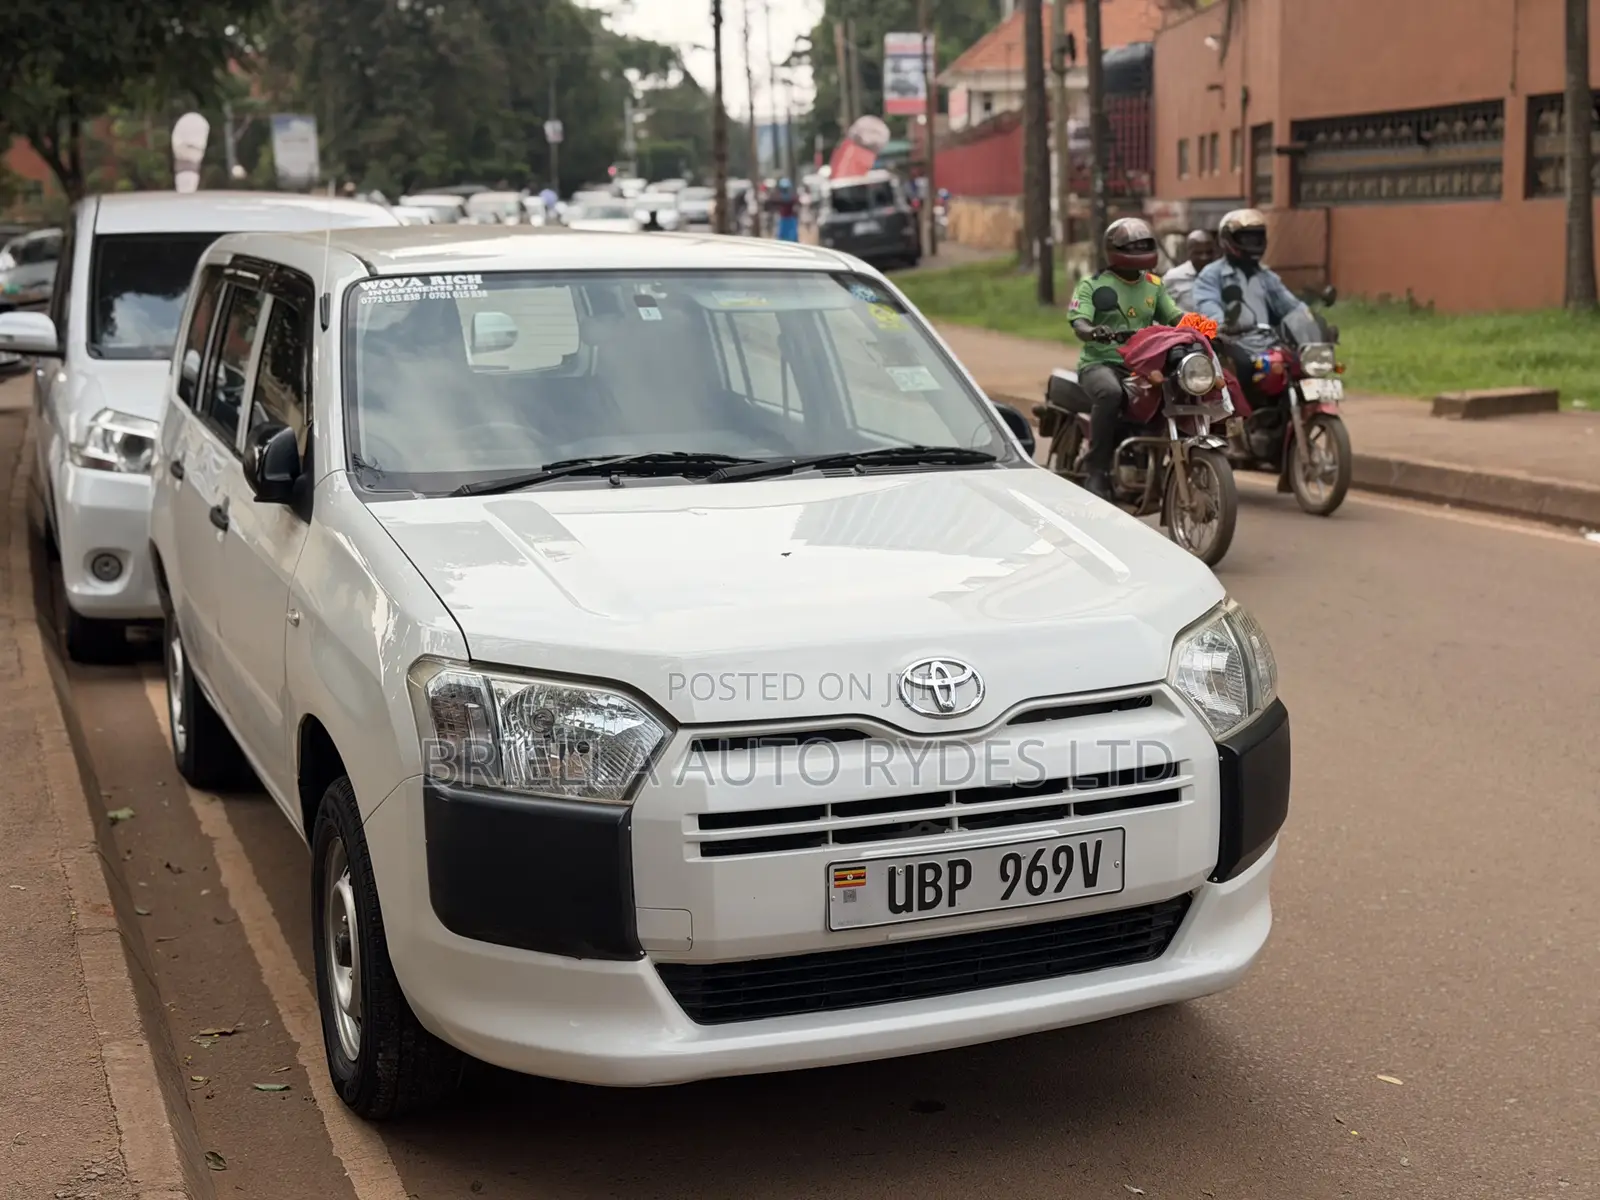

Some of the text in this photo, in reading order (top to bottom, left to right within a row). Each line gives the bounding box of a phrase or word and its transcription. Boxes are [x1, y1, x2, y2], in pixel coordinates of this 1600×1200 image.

[359, 274, 483, 291] WOVA RICH
[368, 285, 453, 297] INVESTMENTS
[888, 838, 1103, 915] UBP 969V
